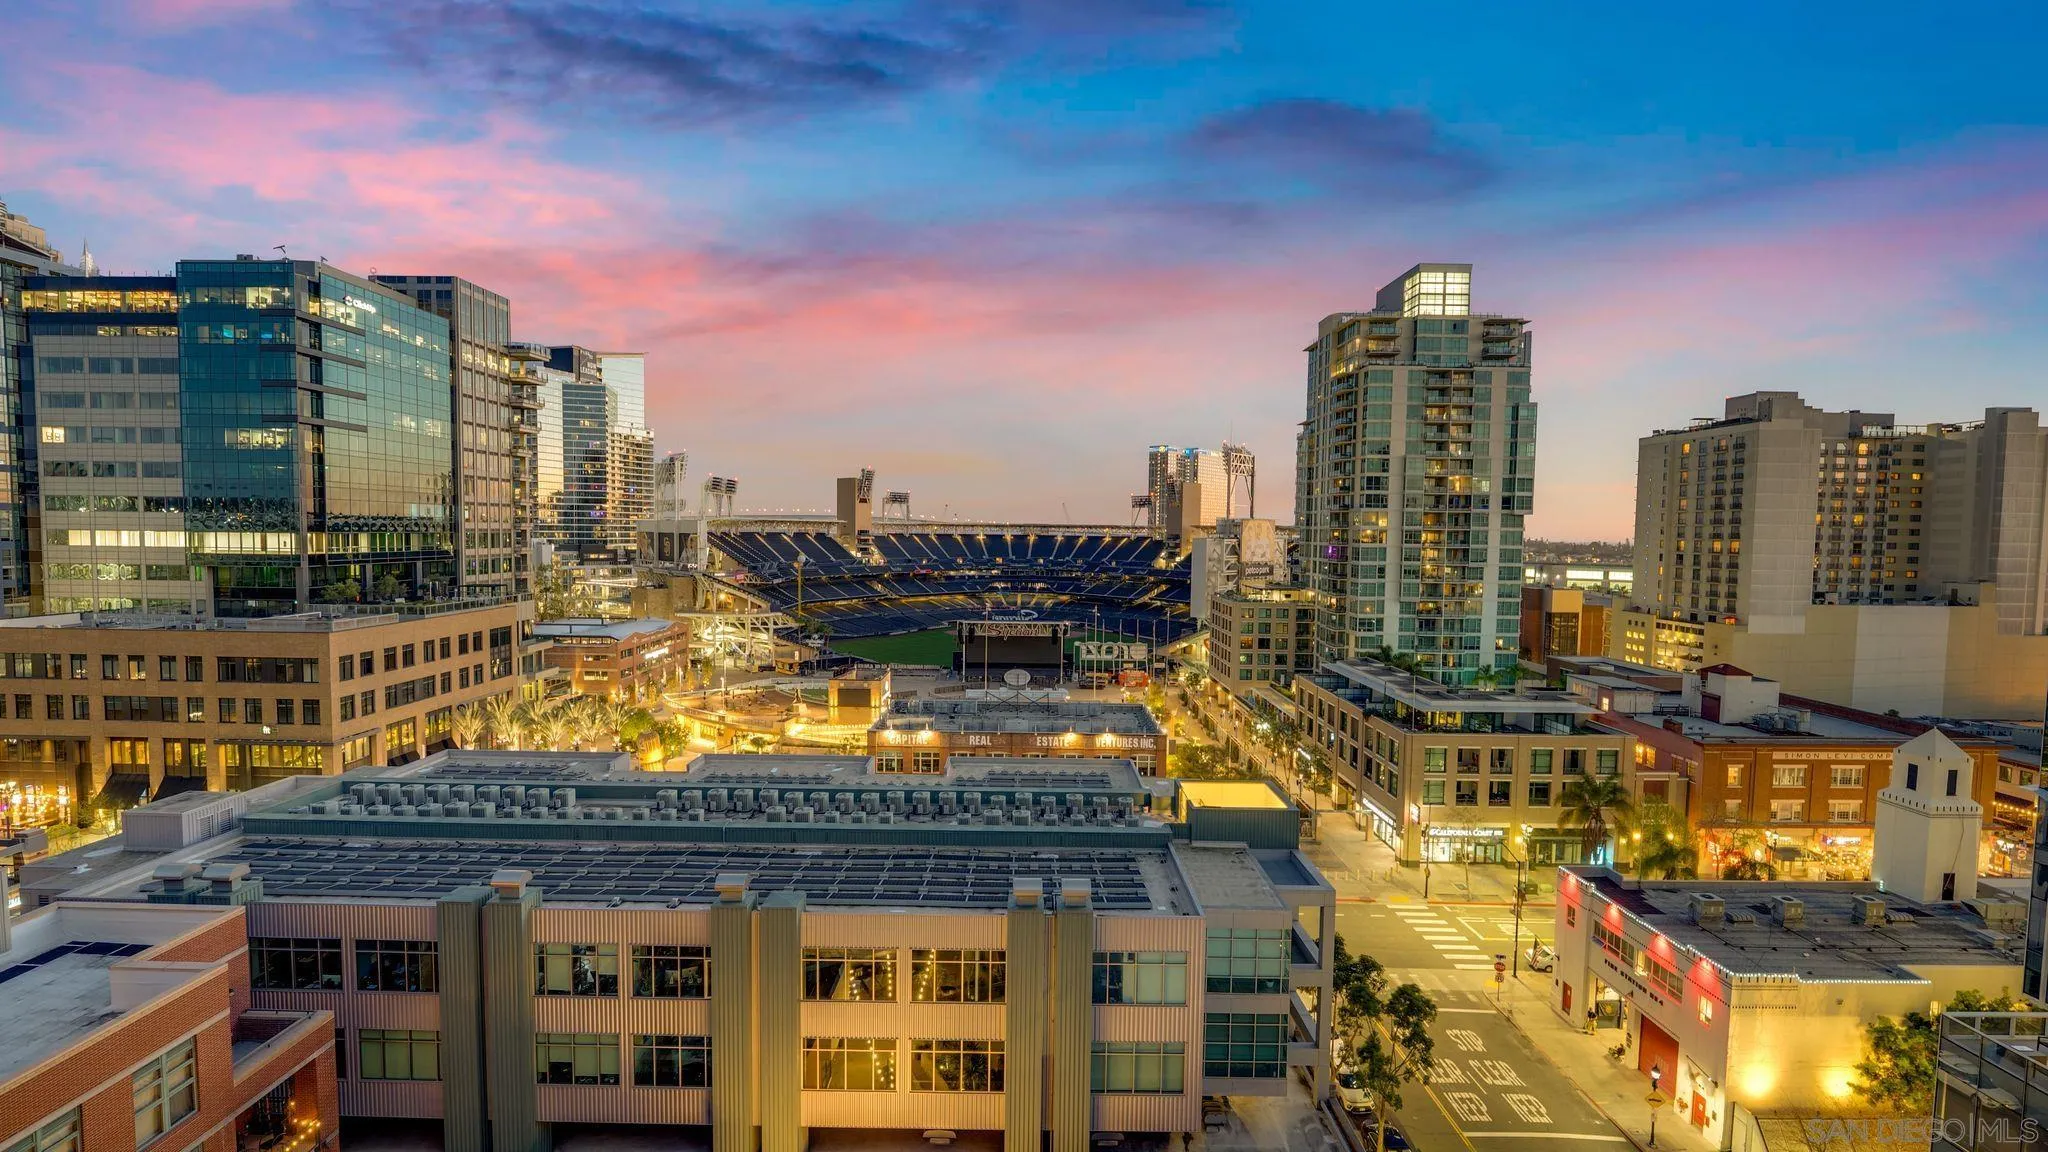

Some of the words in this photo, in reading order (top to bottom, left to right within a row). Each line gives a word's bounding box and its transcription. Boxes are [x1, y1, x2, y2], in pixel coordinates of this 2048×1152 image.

[890, 733, 928, 745] CAPITAL
[969, 735, 992, 746] REAL
[1037, 736, 1069, 747] ESTATE
[1095, 737, 1138, 748] VENTURES
[1140, 738, 1156, 748] INC.
[1445, 1029, 1487, 1053] STOP
[1468, 1060, 1527, 1086] CLEAR
[1443, 1092, 1492, 1122] KEEP
[1501, 1093, 1553, 1124] KEEP
